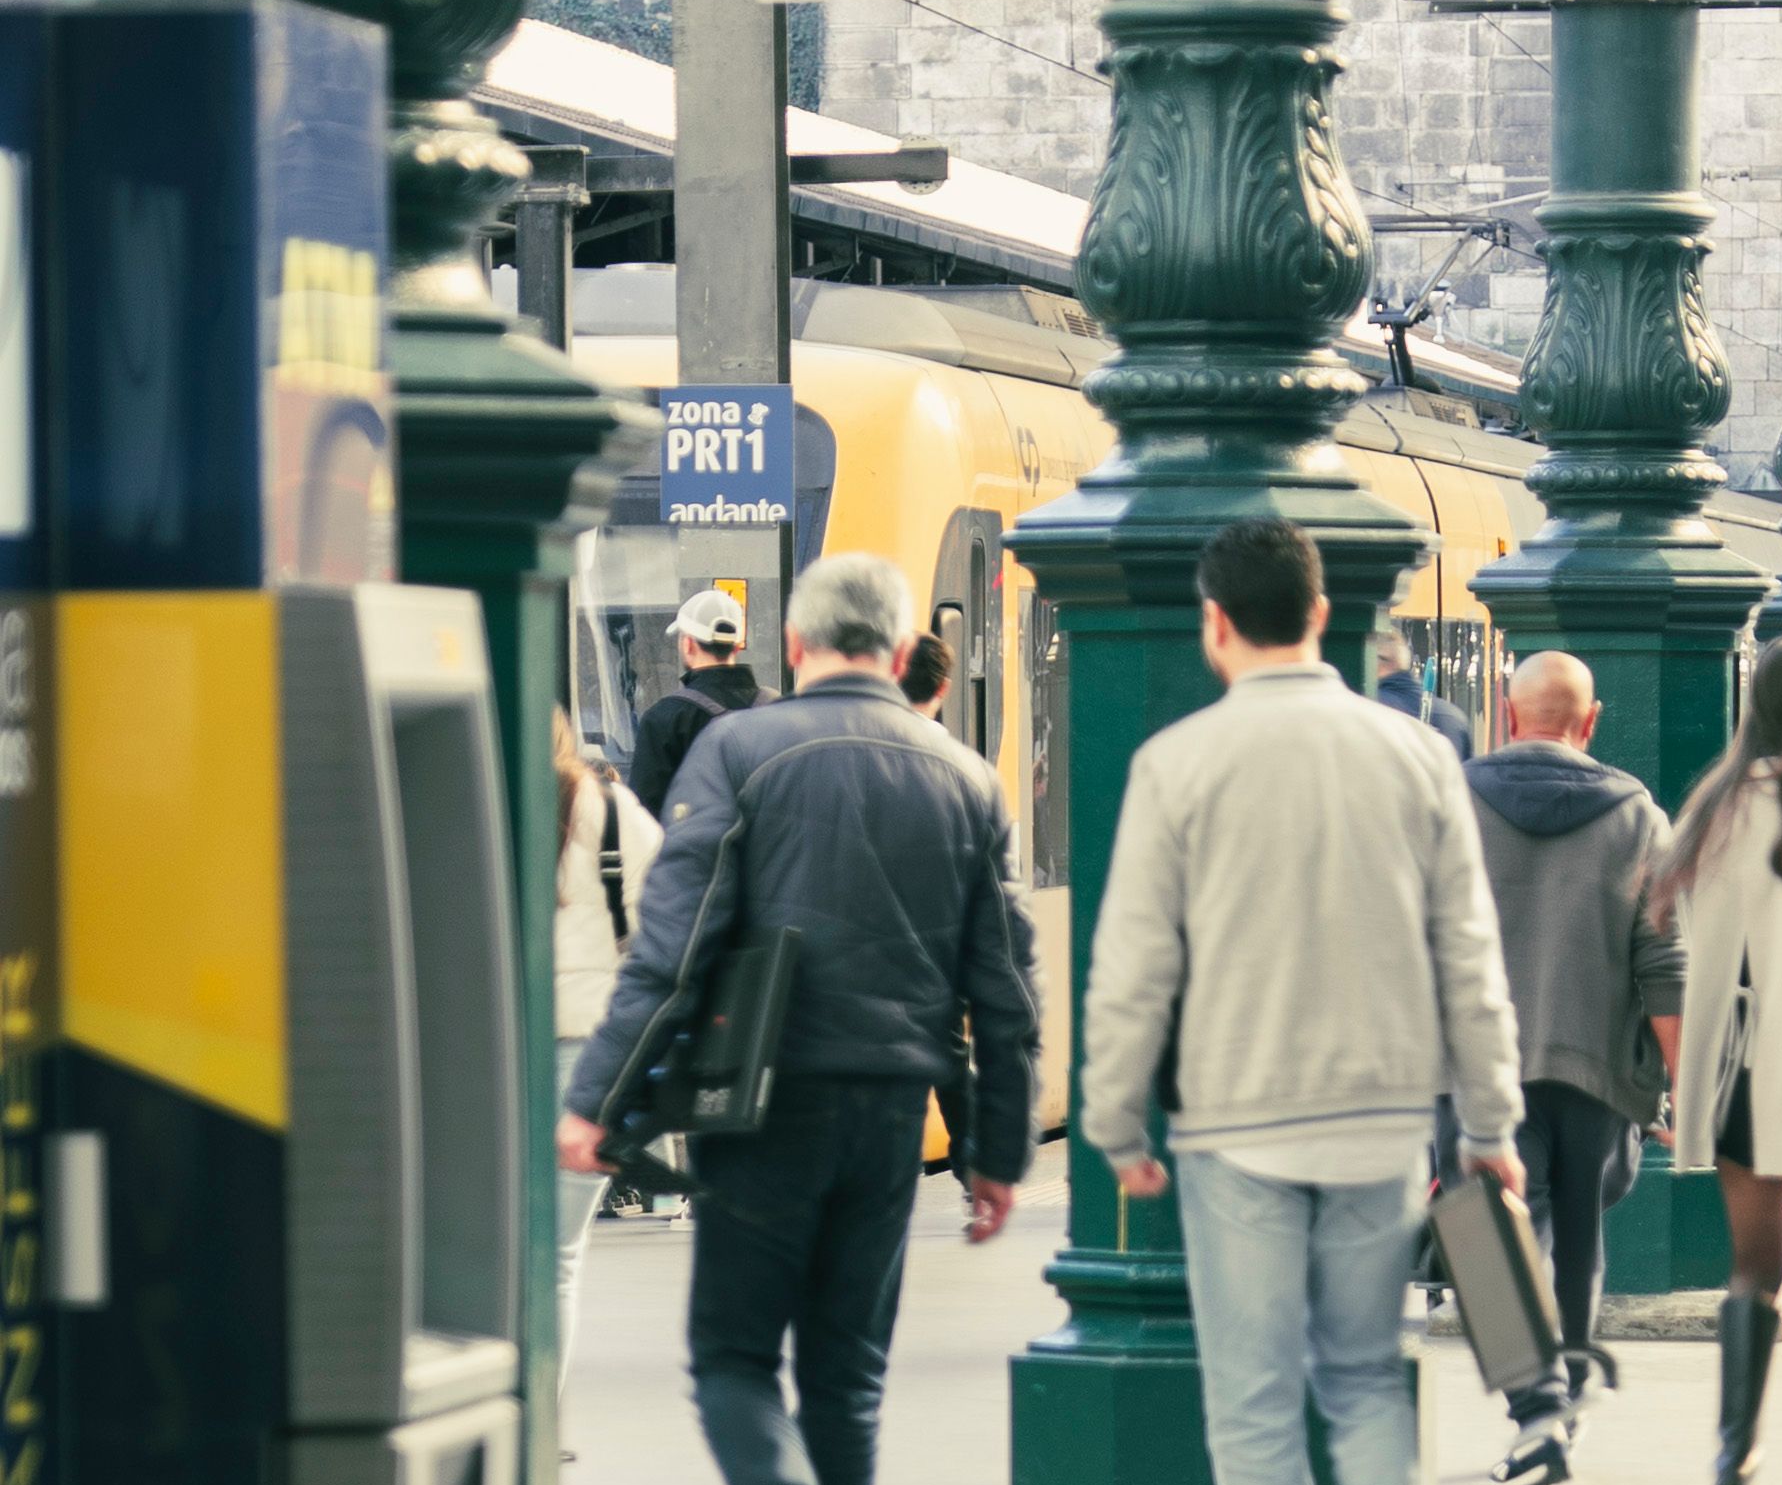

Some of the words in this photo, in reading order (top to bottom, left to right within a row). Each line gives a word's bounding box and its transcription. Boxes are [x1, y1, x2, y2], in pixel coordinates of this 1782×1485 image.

[668, 401, 741, 426] zona
[667, 428, 764, 473] PRT1
[669, 494, 788, 522] andante
